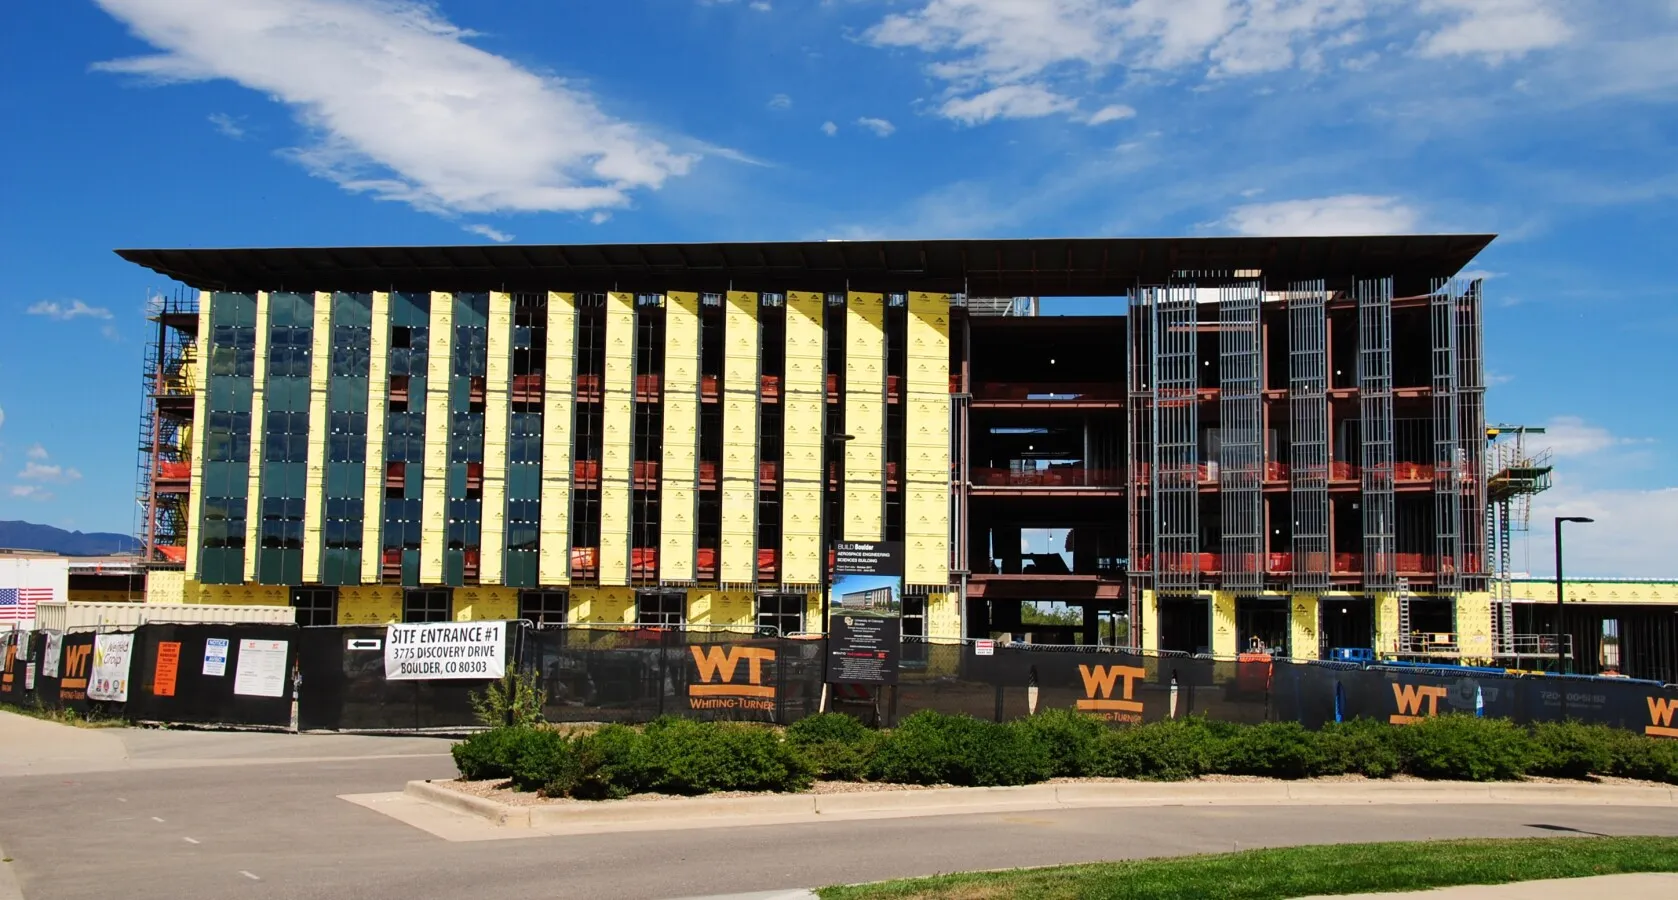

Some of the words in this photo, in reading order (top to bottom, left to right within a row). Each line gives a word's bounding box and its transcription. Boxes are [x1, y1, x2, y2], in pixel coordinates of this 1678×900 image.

[391, 629, 417, 644] SITE
[420, 627, 482, 643] ENTRANCE
[485, 626, 499, 642] #1
[65, 644, 92, 677] WT
[393, 648, 415, 659] 3775
[417, 646, 466, 659] DISCOVERY
[467, 645, 495, 657] DRIVE
[690, 645, 775, 684] WT
[401, 661, 443, 675] BOULDER,
[445, 661, 457, 673] CO
[459, 661, 487, 673] 80303
[1078, 664, 1145, 699] WT
[689, 697, 775, 710] WHITING-TURNER
[1391, 682, 1447, 717] WT
